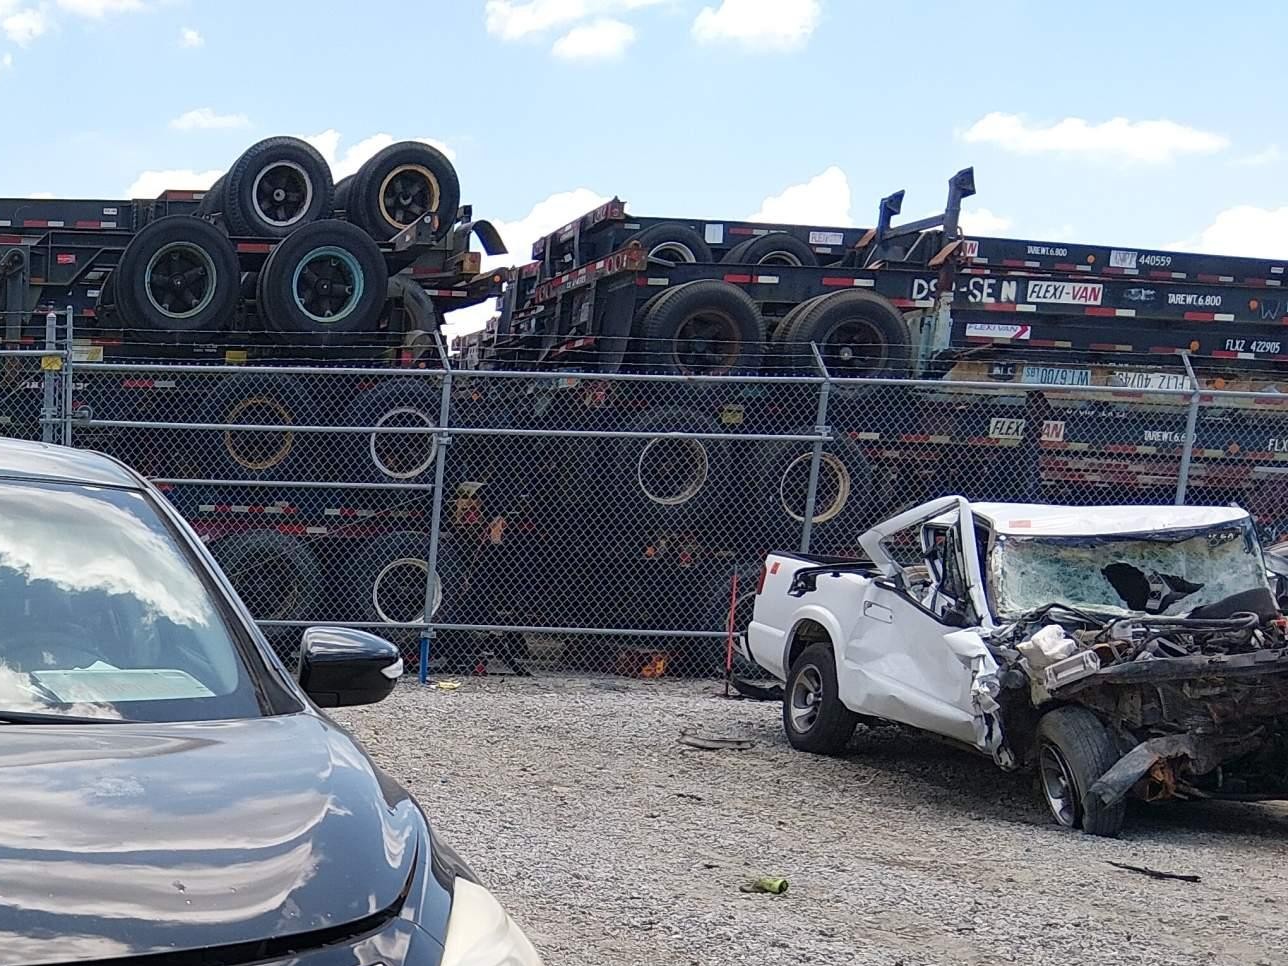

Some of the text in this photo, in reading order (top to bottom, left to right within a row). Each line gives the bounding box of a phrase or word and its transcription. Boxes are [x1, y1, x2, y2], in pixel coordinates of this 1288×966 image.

[1138, 254, 1172, 267] 440559
[1030, 283, 1101, 305] FLEXI-VAN
[1250, 340, 1281, 354] 422905
